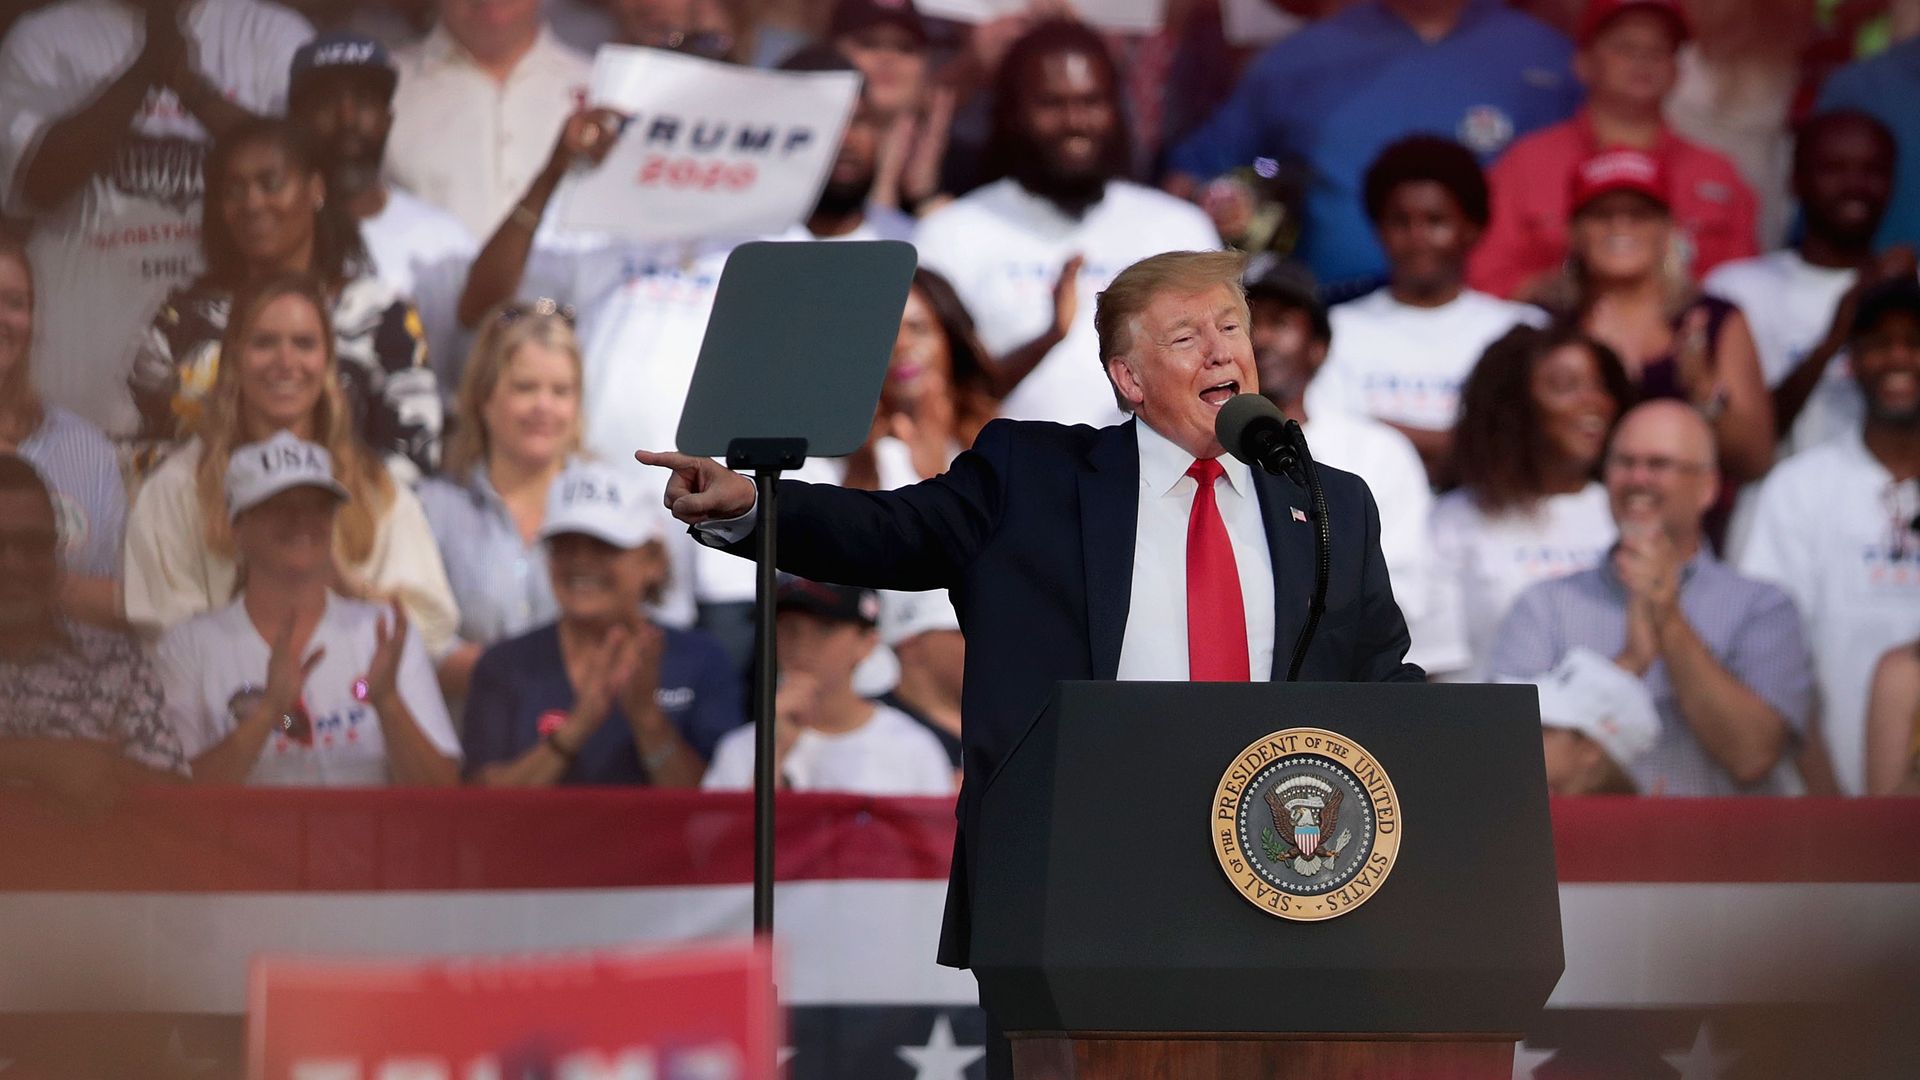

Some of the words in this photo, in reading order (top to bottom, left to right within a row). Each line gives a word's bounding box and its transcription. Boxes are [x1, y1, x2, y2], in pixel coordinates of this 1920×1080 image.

[637, 154, 759, 191] 2020
[261, 445, 323, 474] USA
[561, 479, 622, 510] USA
[1304, 736, 1322, 749] OF
[1325, 740, 1350, 760] THE
[1218, 735, 1299, 822] PRESIDENT
[1353, 755, 1396, 835] UNITED
[1221, 828, 1236, 856] THE
[1228, 858, 1244, 875] OF
[1325, 852, 1389, 912] STATES
[1243, 872, 1293, 912] SEAL
